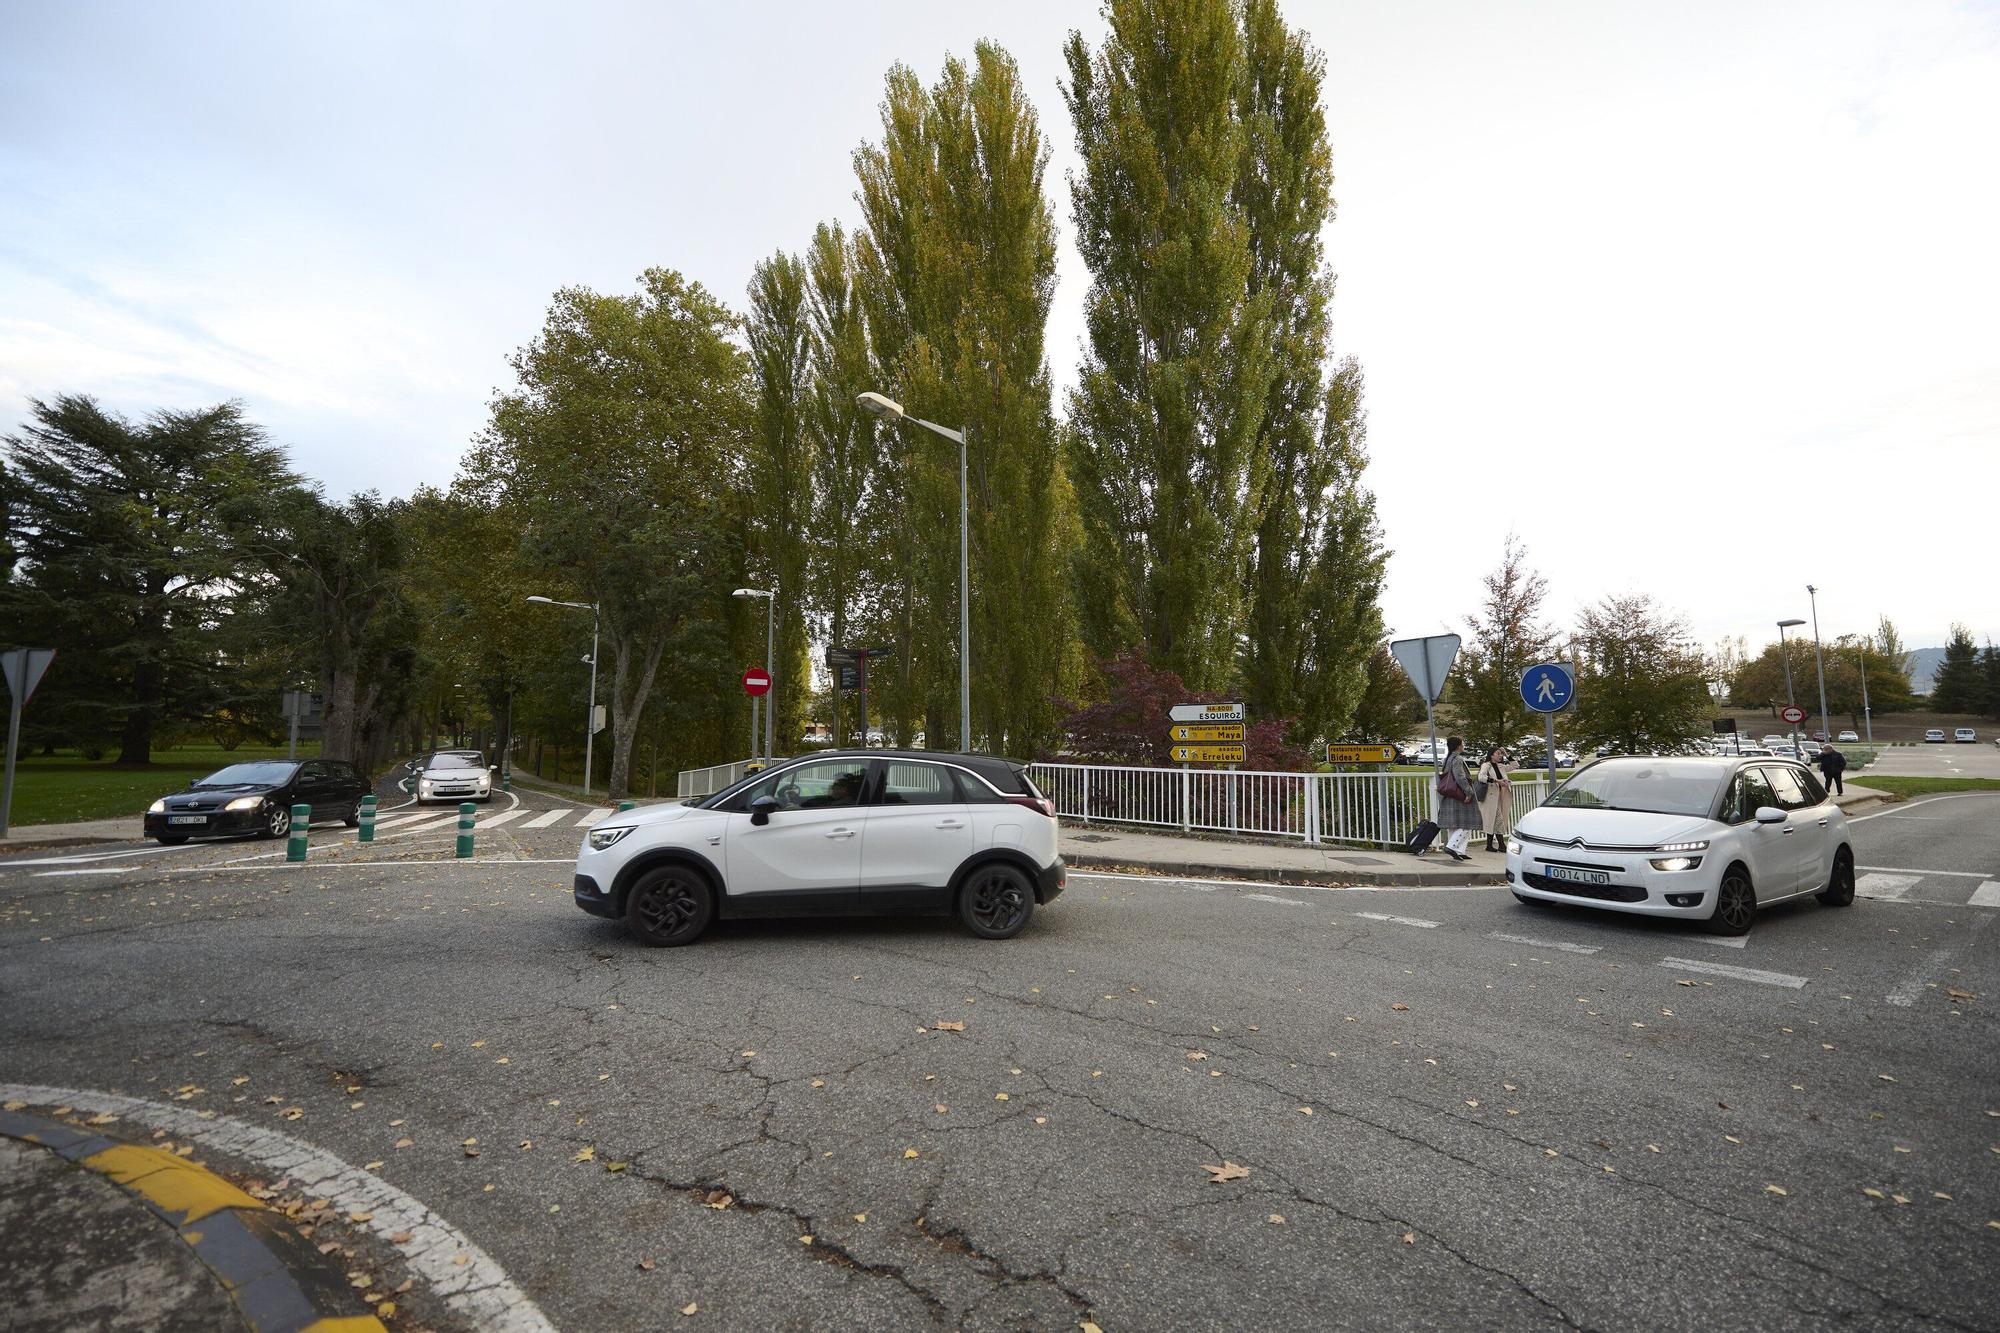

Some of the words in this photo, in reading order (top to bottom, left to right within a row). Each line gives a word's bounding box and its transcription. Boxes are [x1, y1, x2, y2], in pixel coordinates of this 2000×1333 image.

[1330, 753, 1352, 761] Bidea
[1355, 753, 1360, 761] 2
[1553, 868, 1580, 880] 0014
[1583, 872, 1606, 883] LND
